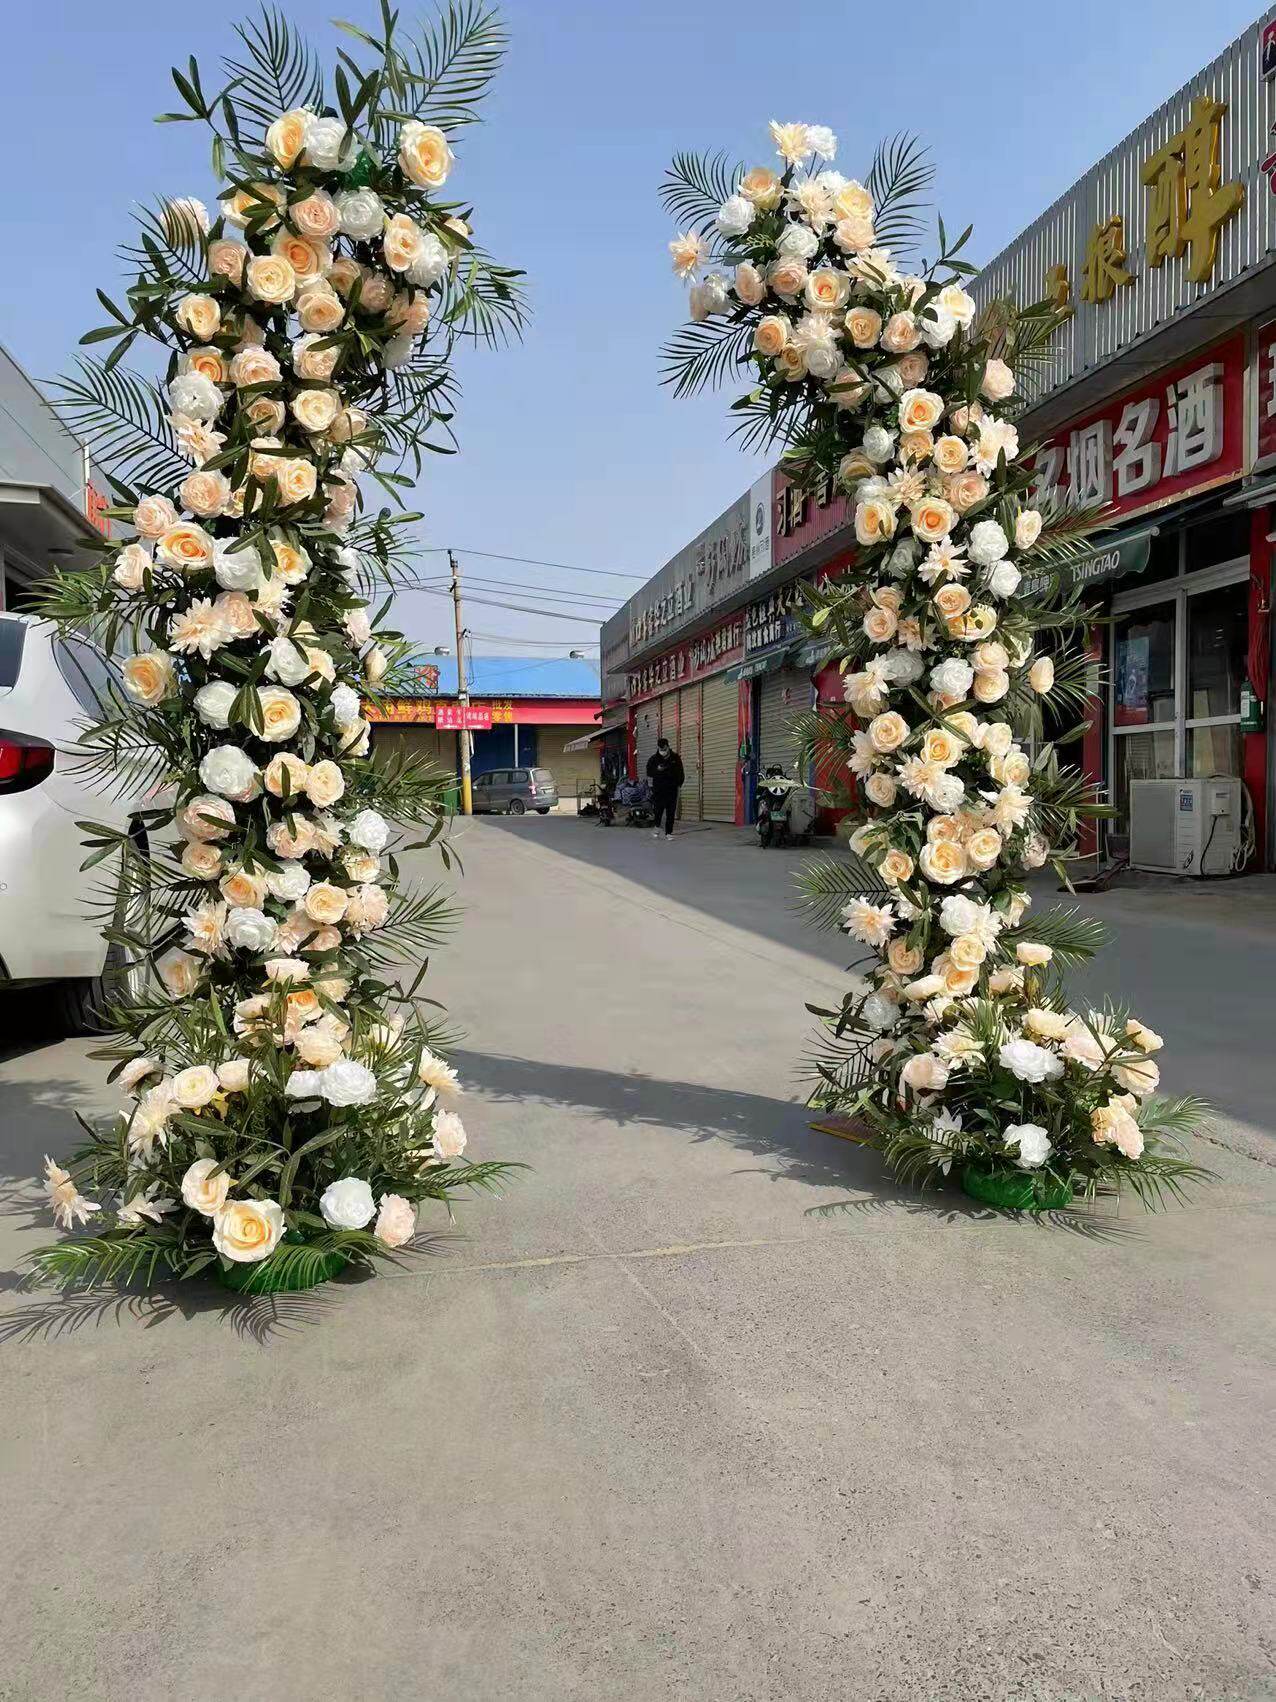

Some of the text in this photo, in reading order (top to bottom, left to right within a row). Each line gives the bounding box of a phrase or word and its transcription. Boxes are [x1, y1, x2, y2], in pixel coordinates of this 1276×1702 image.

[1028, 363, 1224, 510] 名烟名酒
[1071, 550, 1121, 582] TSINGTAO
